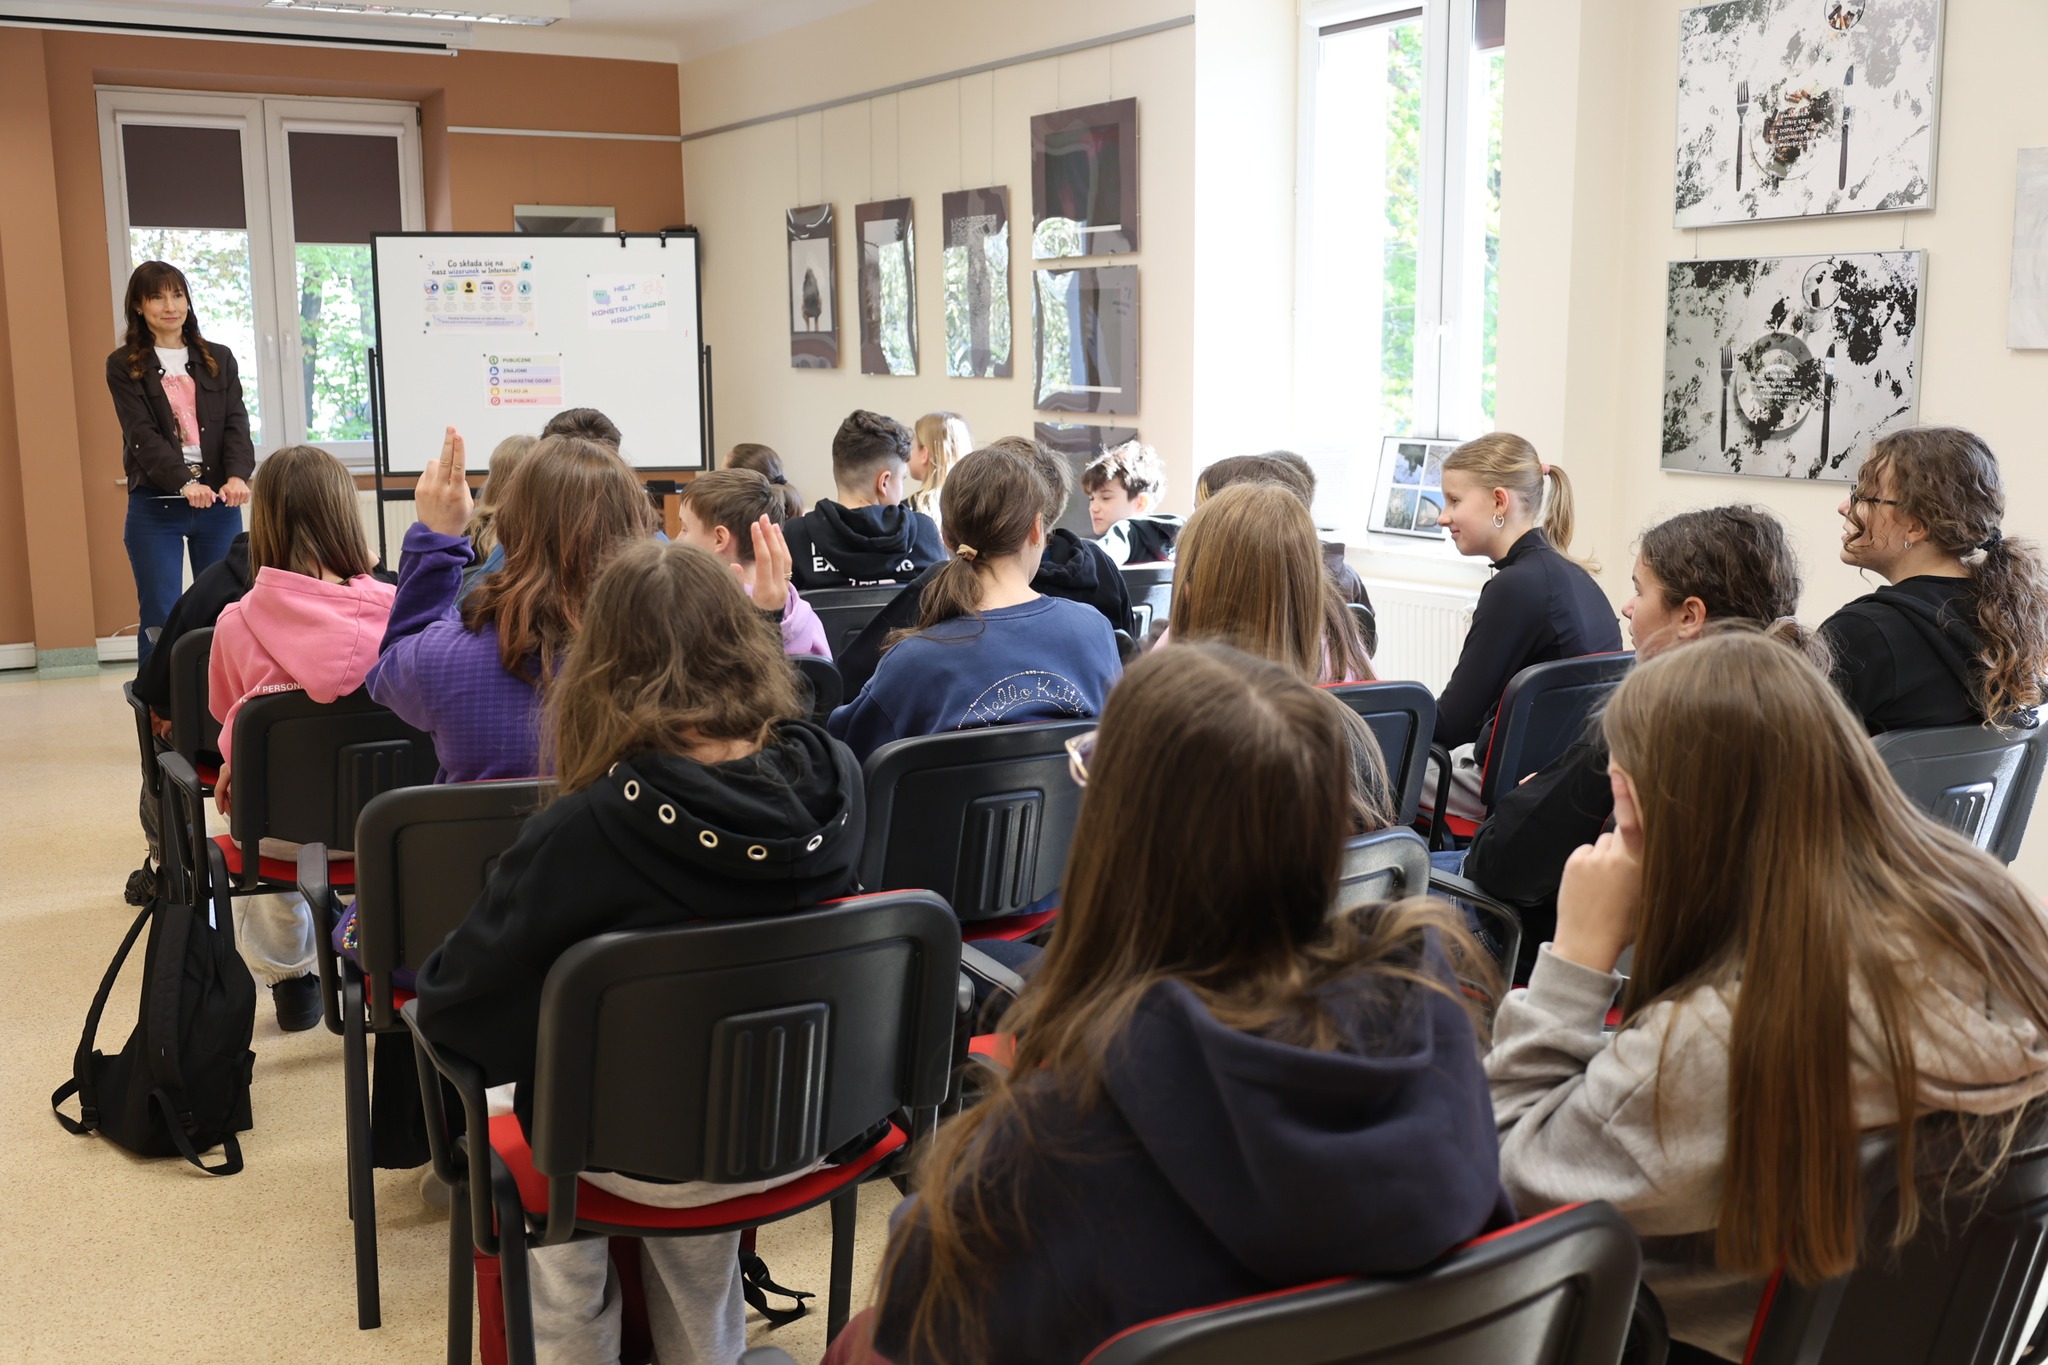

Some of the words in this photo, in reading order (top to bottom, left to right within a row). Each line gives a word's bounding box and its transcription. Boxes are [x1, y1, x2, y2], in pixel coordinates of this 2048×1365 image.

[447, 259, 457, 267] Co
[459, 259, 482, 267] składa
[613, 283, 636, 292] HEJT
[591, 300, 666, 317] KONSTRUKTYWNA
[610, 313, 651, 324] KRYTYKA
[973, 684, 1033, 722] Hello
[1037, 677, 1084, 713] Kitty
